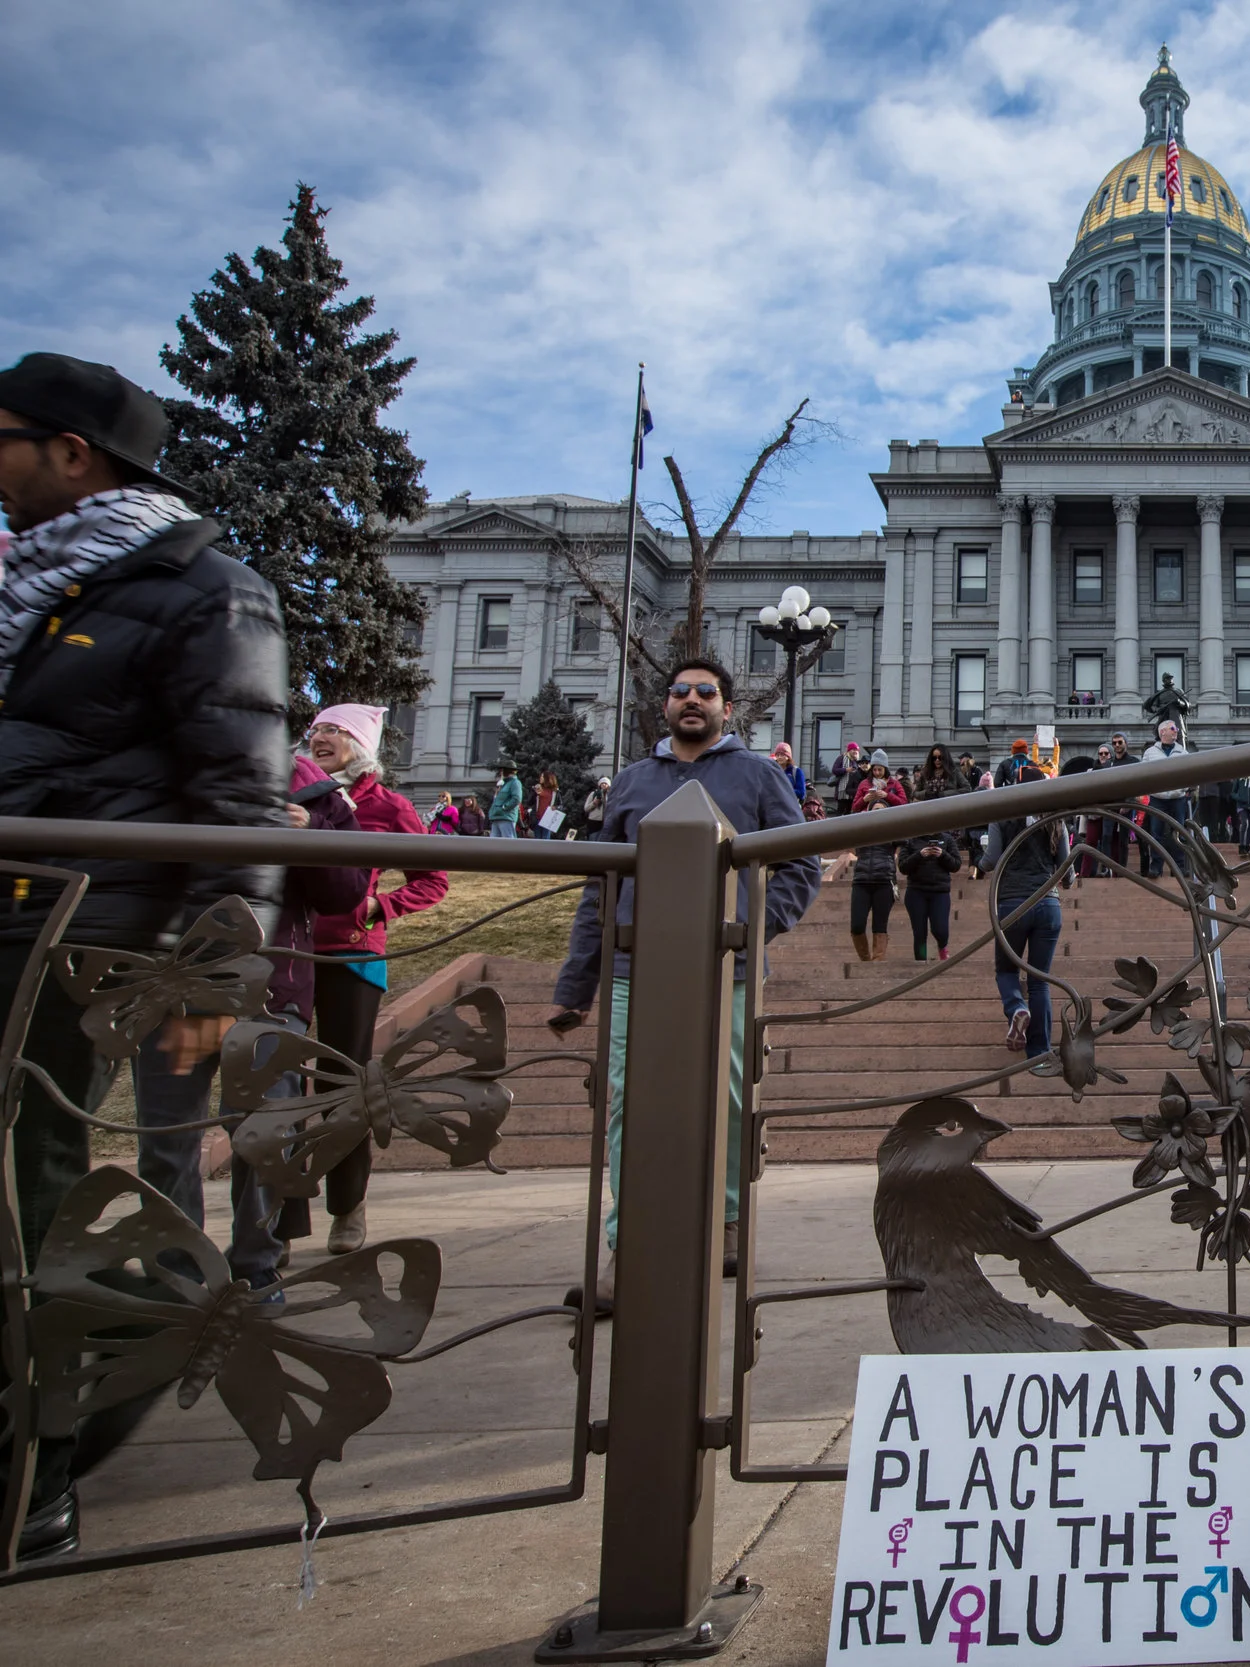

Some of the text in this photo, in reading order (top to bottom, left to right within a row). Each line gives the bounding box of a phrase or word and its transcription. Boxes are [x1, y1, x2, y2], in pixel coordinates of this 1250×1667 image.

[879, 1364, 1246, 1442] A WOMAN'S
[870, 1441, 1219, 1513] PLACE IS
[939, 1511, 1179, 1571] IN THE
